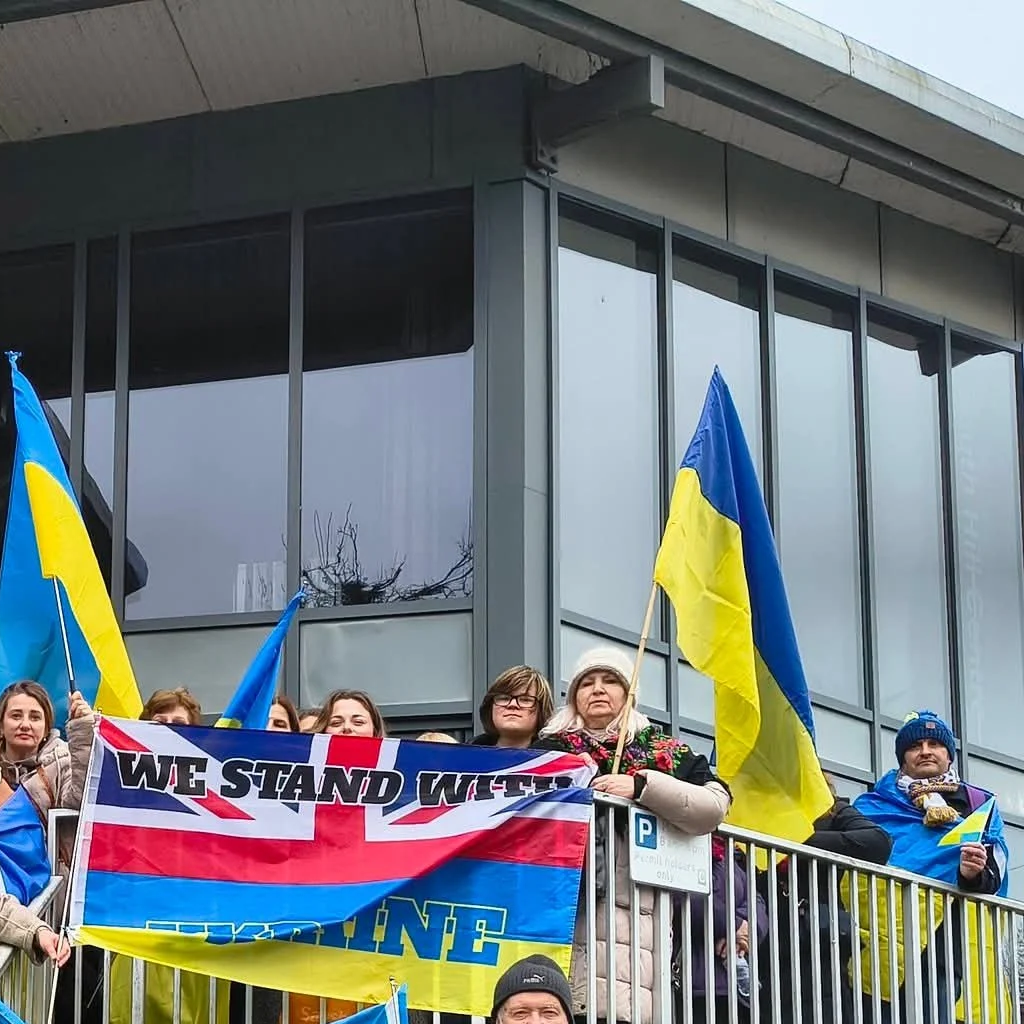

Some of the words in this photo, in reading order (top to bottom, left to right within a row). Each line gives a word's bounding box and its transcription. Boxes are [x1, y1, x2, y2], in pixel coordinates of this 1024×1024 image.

[115, 750, 208, 798] WE
[219, 758, 405, 806] STAND
[639, 818, 653, 844] P
